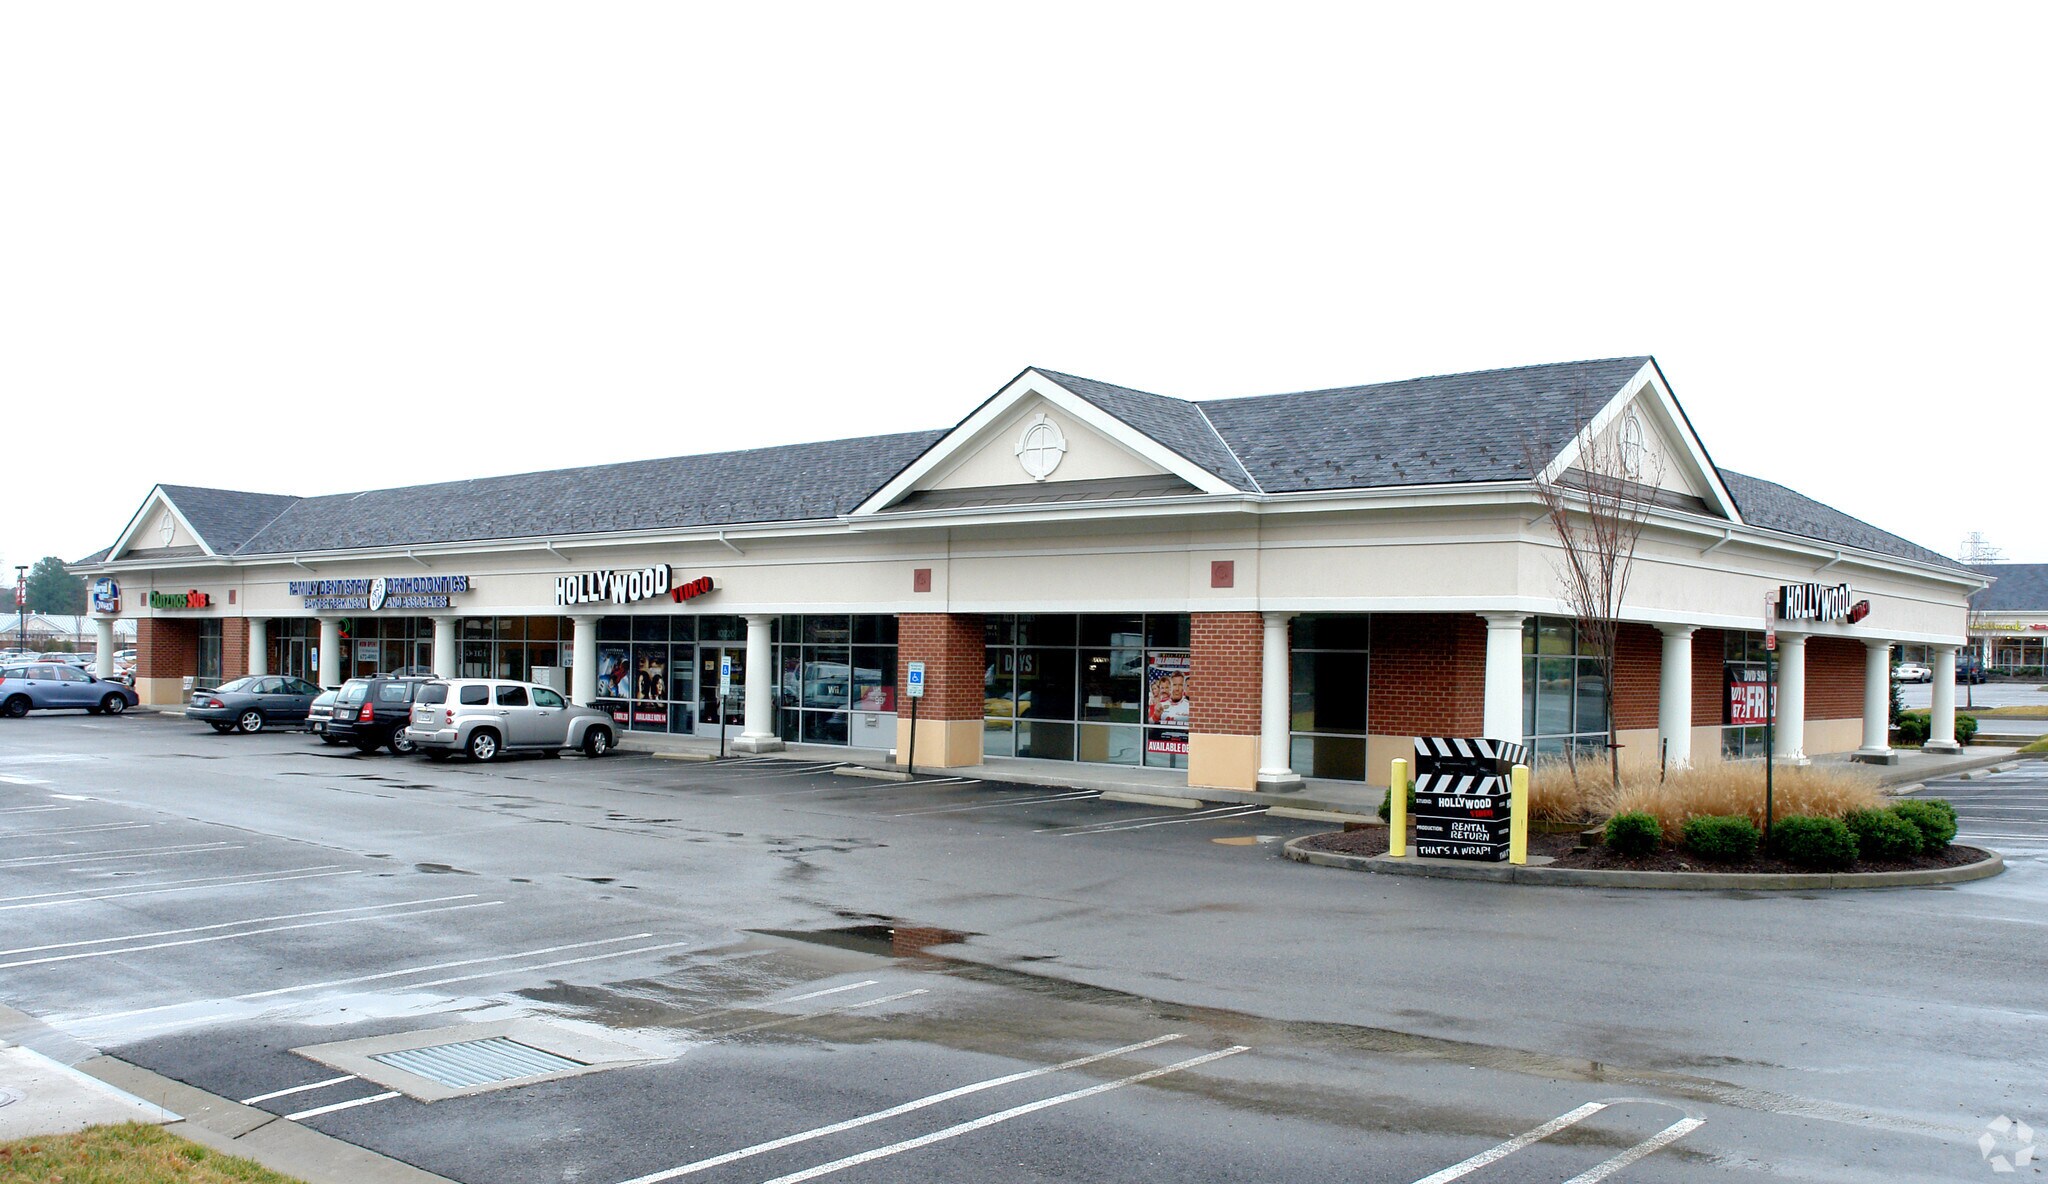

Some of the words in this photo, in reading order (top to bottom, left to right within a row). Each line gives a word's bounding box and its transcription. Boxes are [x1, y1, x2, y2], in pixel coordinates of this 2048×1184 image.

[289, 580, 318, 596] FAMILY
[320, 578, 369, 595] DENTISTRY
[387, 575, 466, 594] ORTHODONTICS
[555, 563, 669, 606] HOLLYWOOD
[671, 575, 711, 604] VIDEO
[386, 596, 402, 608] AND
[402, 595, 447, 608] ASSOCIATES
[1786, 583, 1852, 623] HOLLYWOOD
[1744, 670, 1756, 682] DVD
[1757, 670, 1769, 682] SAL
[828, 686, 839, 695] Wii
[1148, 741, 1181, 752] AVAILABLE
[1438, 797, 1492, 810] HOLLYWOOD
[1451, 821, 1488, 833] RENTAL
[1450, 830, 1490, 842] RETURN
[1419, 846, 1451, 855] THAT'S
[1453, 846, 1460, 855] A
[1461, 846, 1491, 856] WRAP!
